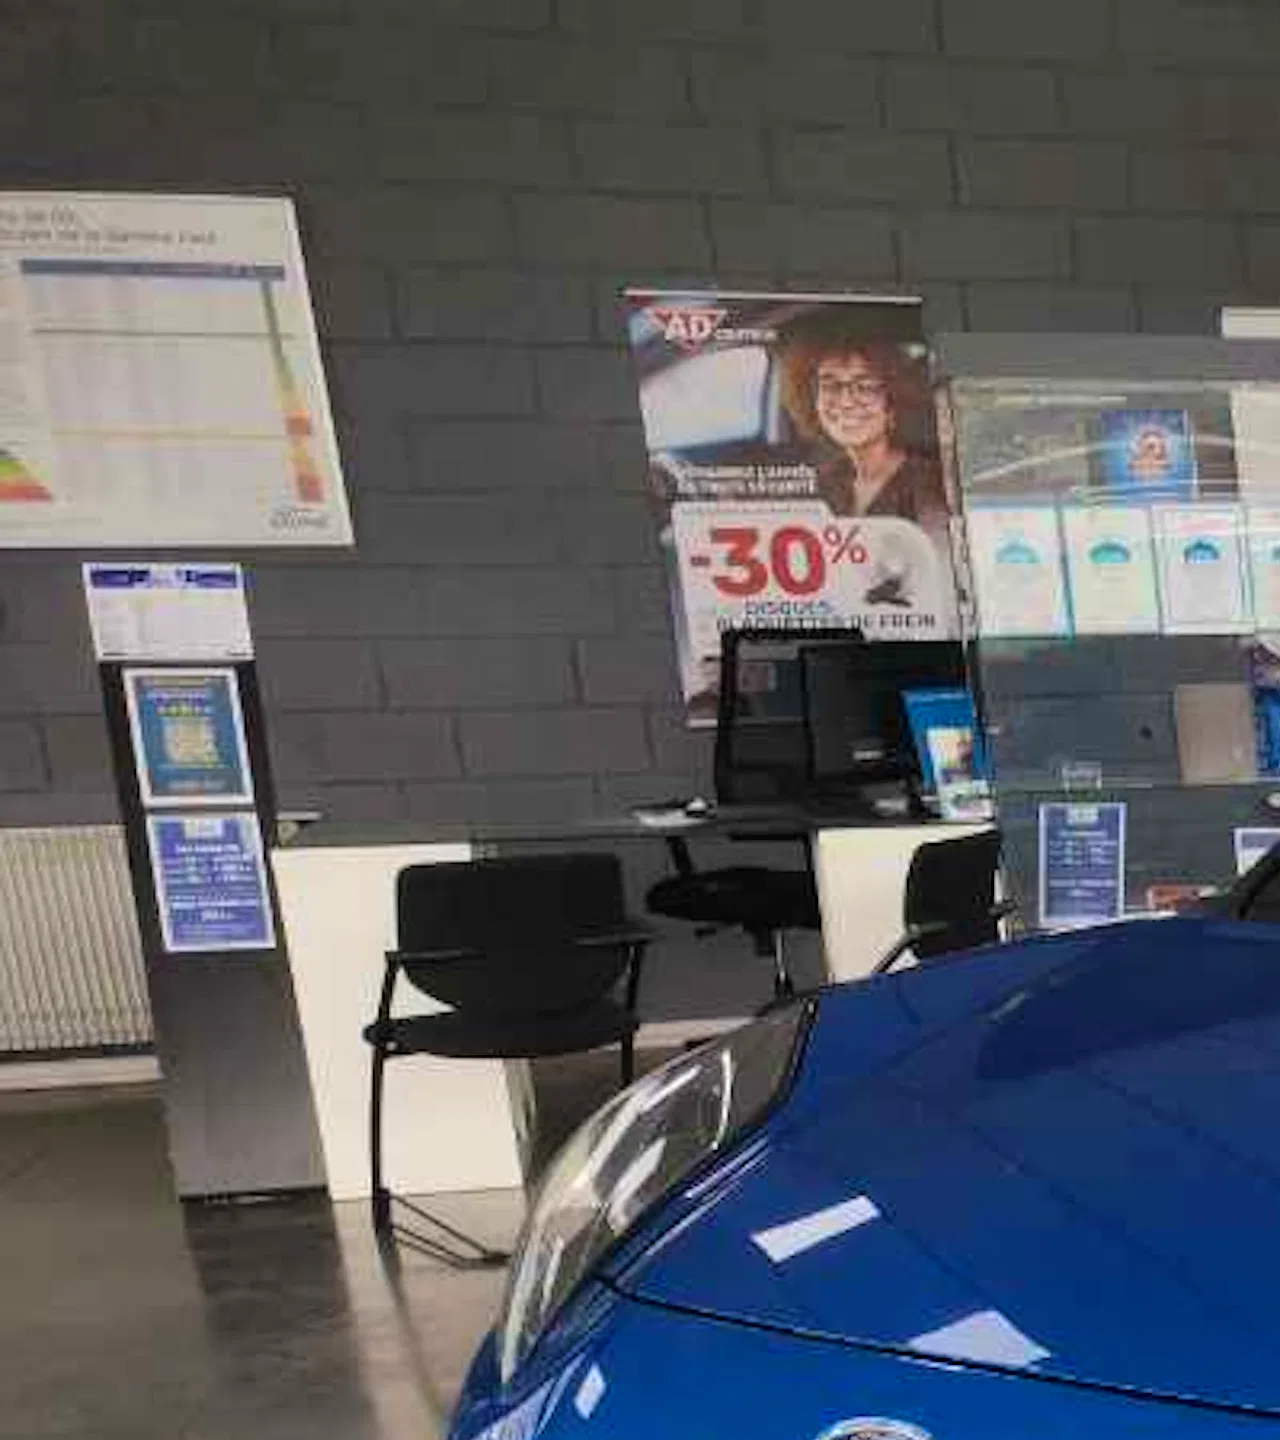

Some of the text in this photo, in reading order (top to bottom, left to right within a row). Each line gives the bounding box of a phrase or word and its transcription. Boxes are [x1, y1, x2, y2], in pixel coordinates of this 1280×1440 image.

[664, 311, 713, 341] AD
[689, 524, 868, 596] -30%
[745, 600, 834, 616] DISQUES
[879, 613, 936, 629] FREIN
